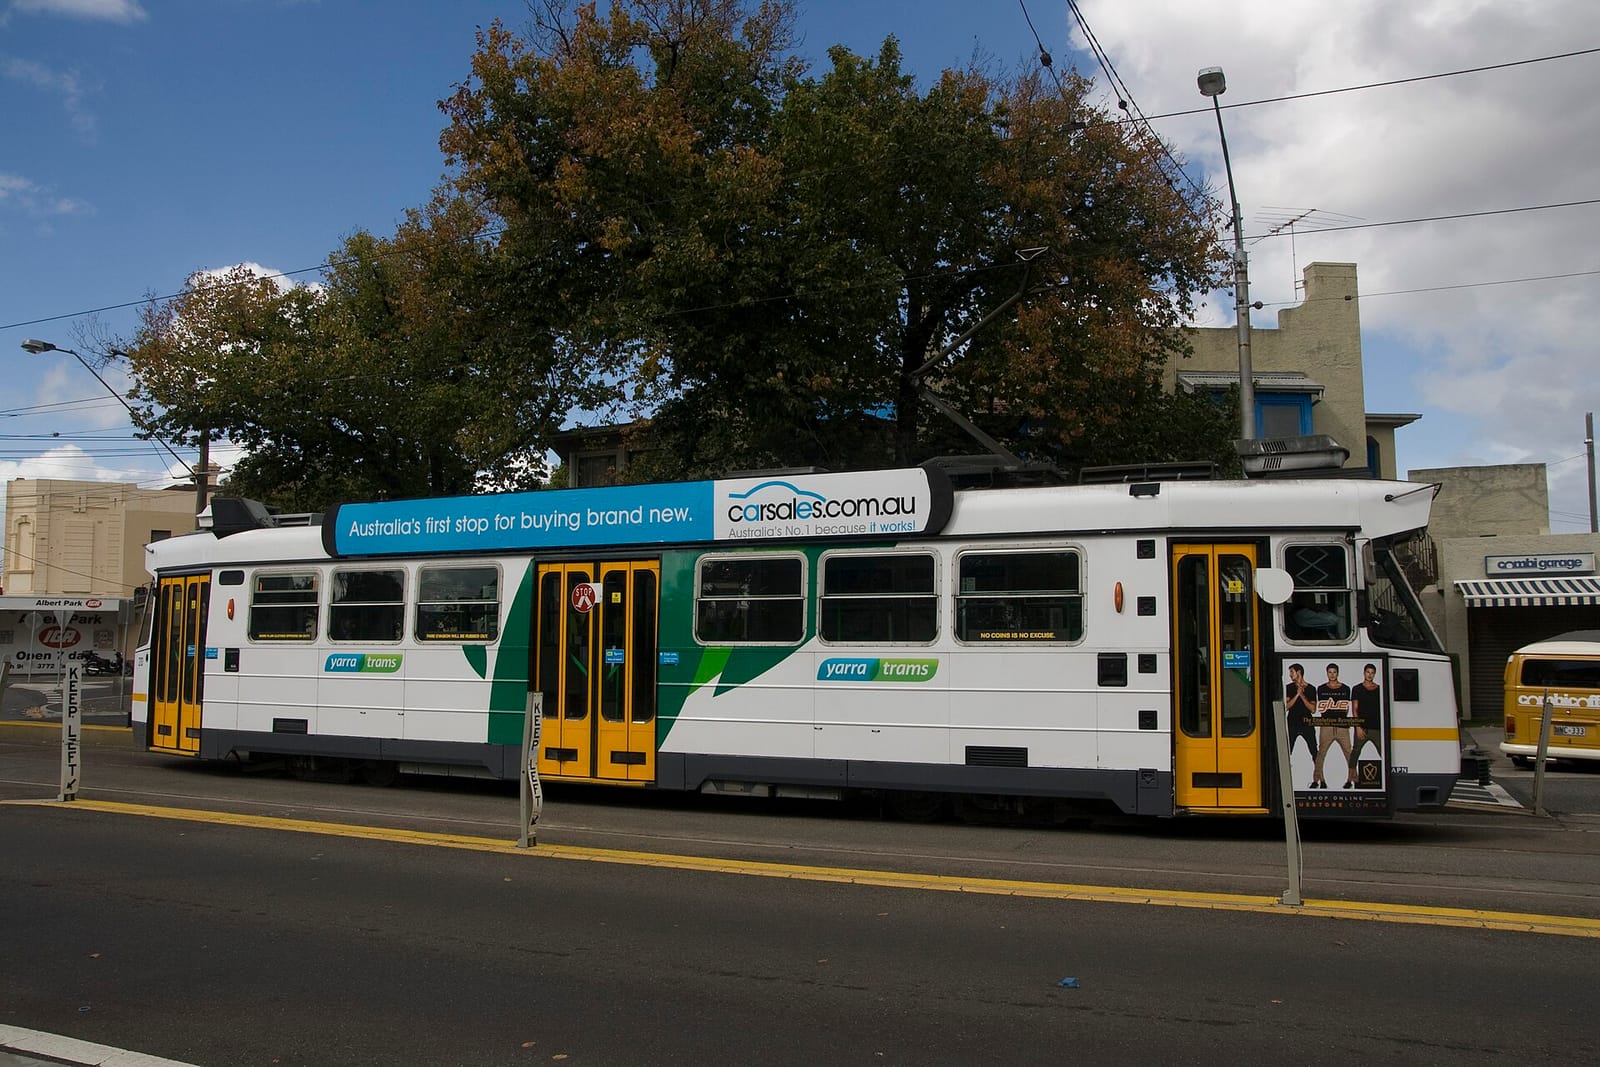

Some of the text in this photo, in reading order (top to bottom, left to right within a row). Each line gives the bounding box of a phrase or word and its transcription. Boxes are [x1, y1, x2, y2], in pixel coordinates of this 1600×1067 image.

[727, 496, 916, 523] carsales.com.au
[349, 505, 693, 537] Australia's first stop for buying brand new.
[728, 525, 783, 538] Australia's
[815, 523, 866, 536] because
[869, 522, 877, 532] it
[879, 520, 916, 532] works!
[1497, 558, 1583, 570] combi garage
[575, 587, 593, 597] STOP
[16, 651, 52, 662] Open
[330, 657, 397, 669] yarra trams
[826, 661, 929, 677] yarra trams
[68, 667, 78, 718] KEEP
[1318, 697, 1349, 713] glue
[67, 725, 77, 776] LEFT
[529, 702, 541, 807] KEEP LEFT
